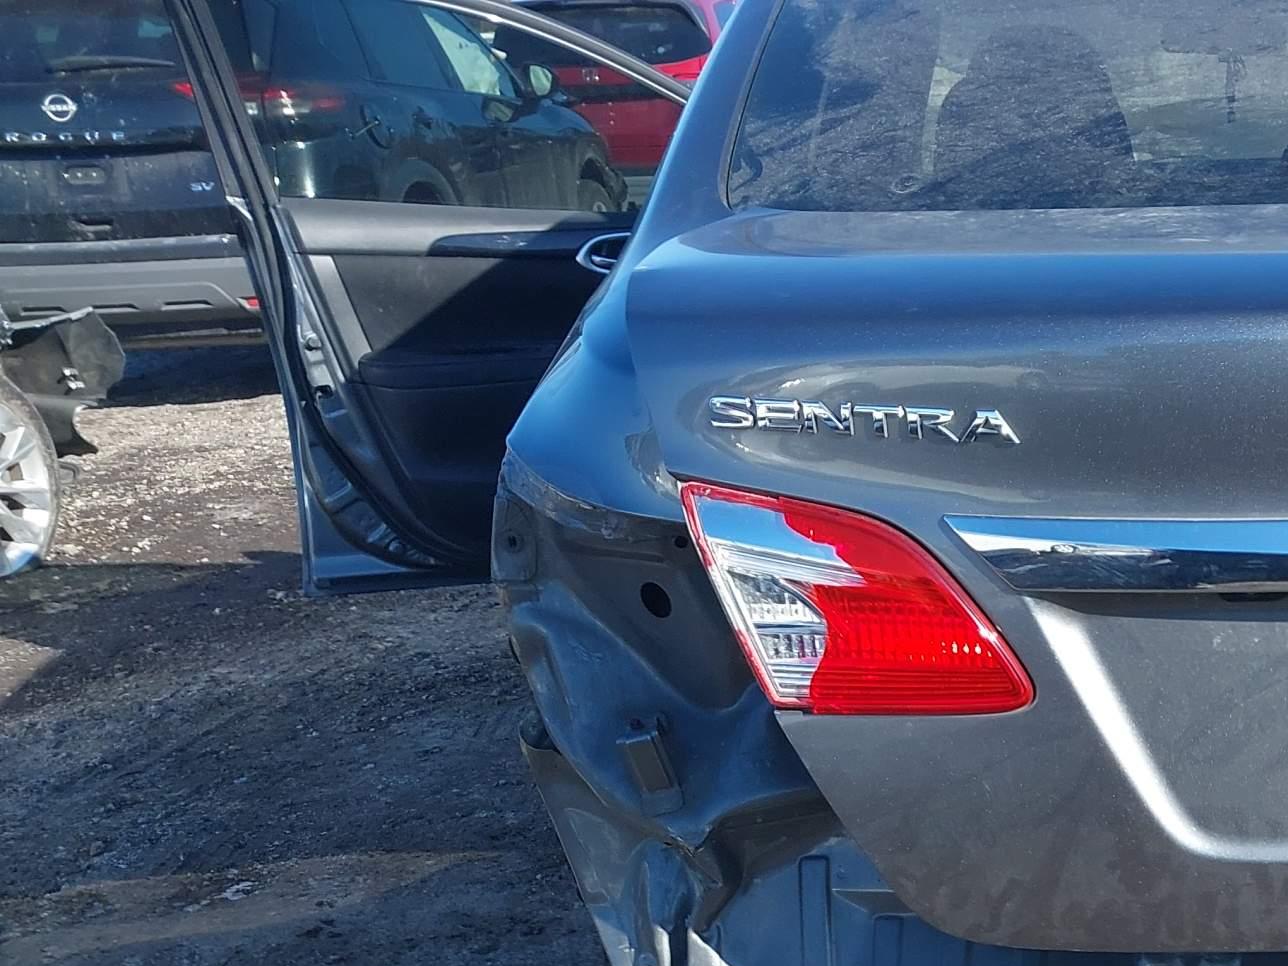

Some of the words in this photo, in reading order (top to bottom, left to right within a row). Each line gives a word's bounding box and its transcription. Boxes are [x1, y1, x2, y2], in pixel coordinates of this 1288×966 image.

[5, 131, 126, 144] ROGUE
[189, 181, 215, 192] SV
[709, 395, 1021, 444] SENTRA
